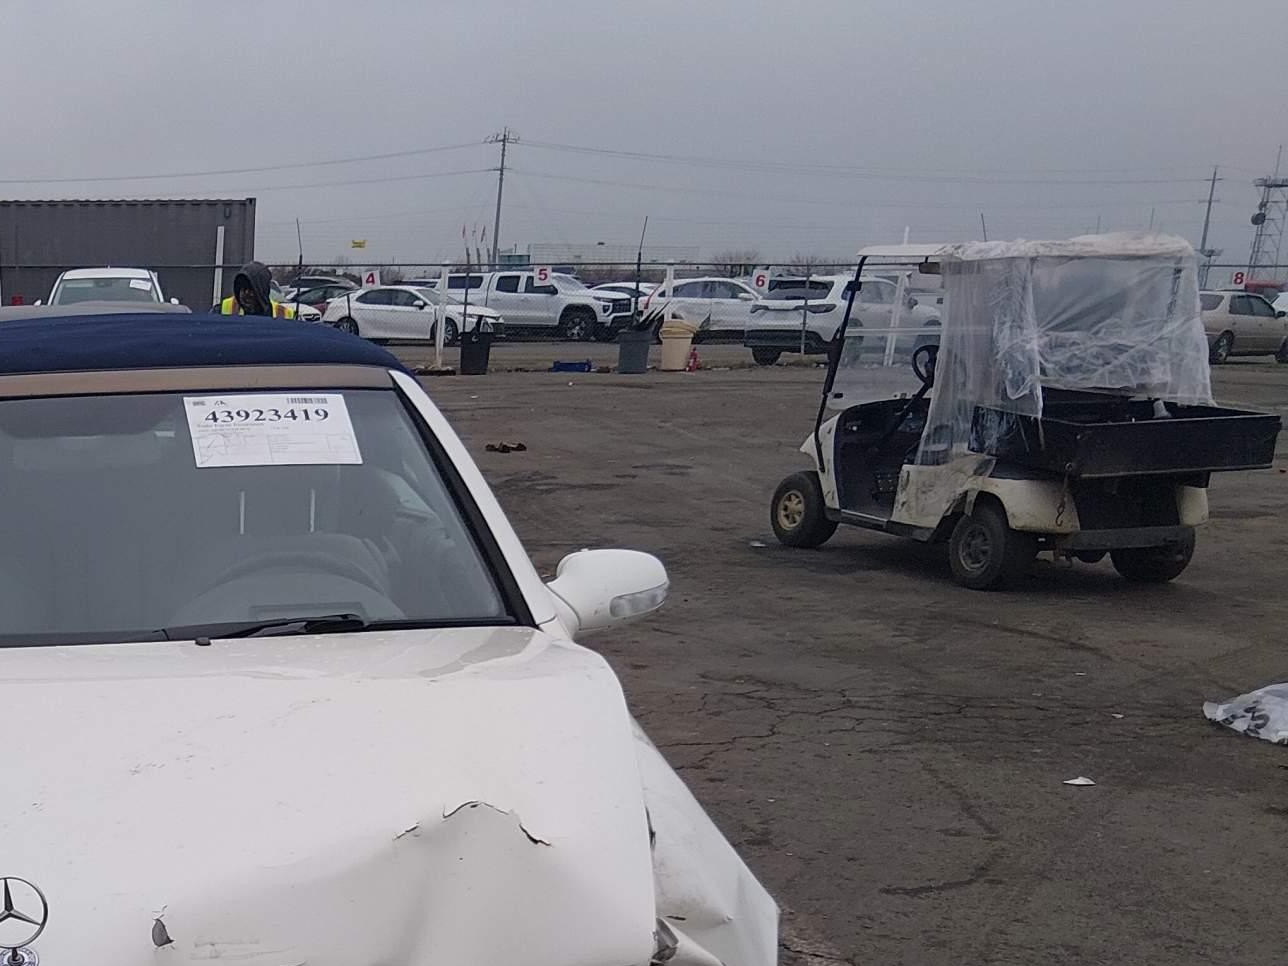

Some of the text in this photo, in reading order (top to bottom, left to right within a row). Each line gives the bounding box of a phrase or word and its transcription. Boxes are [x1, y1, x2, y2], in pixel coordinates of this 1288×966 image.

[365, 272, 375, 284] 4
[538, 268, 548, 281] 5
[755, 274, 766, 288] 6
[1234, 271, 1244, 285] 8
[205, 408, 329, 423] 43923419
